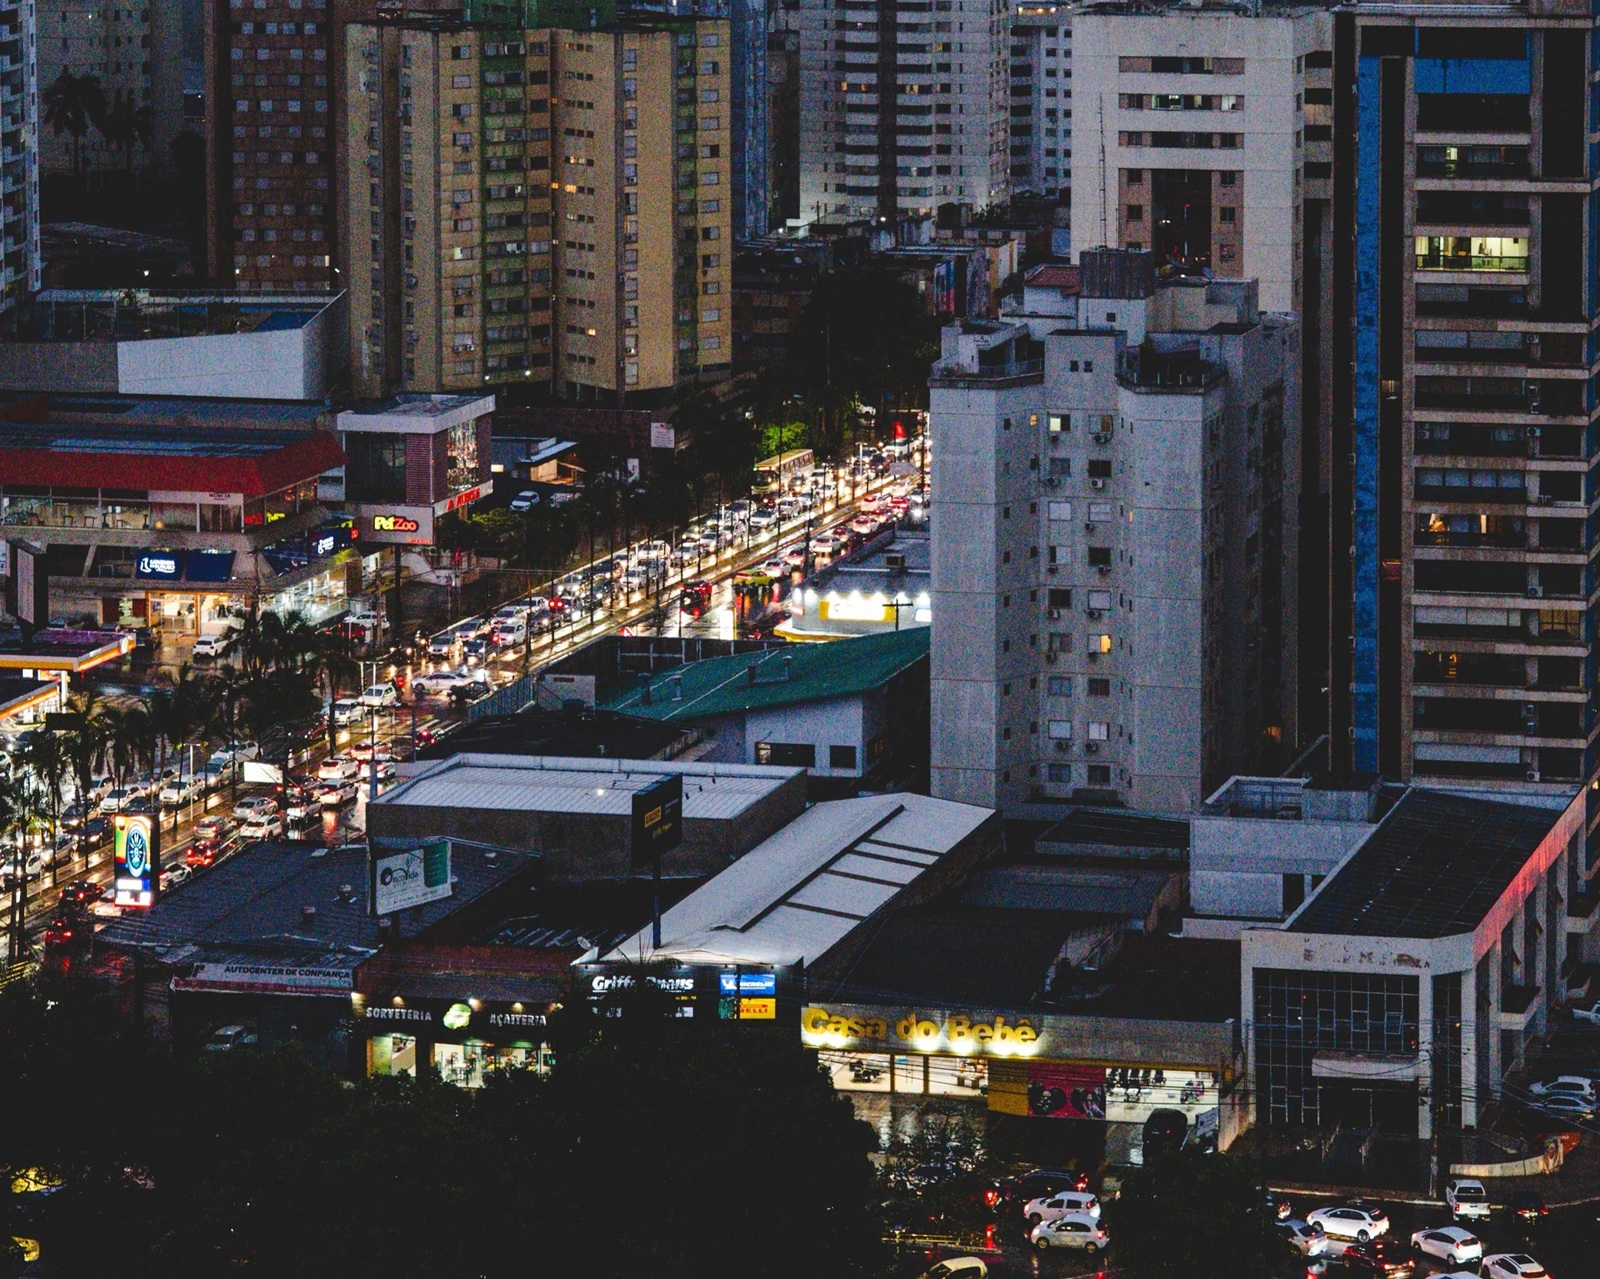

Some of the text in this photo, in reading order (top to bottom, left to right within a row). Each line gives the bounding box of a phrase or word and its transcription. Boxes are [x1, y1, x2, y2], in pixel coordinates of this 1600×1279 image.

[374, 516, 417, 531] PetZoo
[224, 966, 284, 976] AUTOCENTER
[298, 969, 350, 980] CONFIANÇA
[592, 975, 637, 990] Griff
[366, 1007, 432, 1021] SORVETERIA
[490, 1013, 547, 1027] AÇAITERIA
[802, 1007, 1037, 1046] Casa do Bebê
